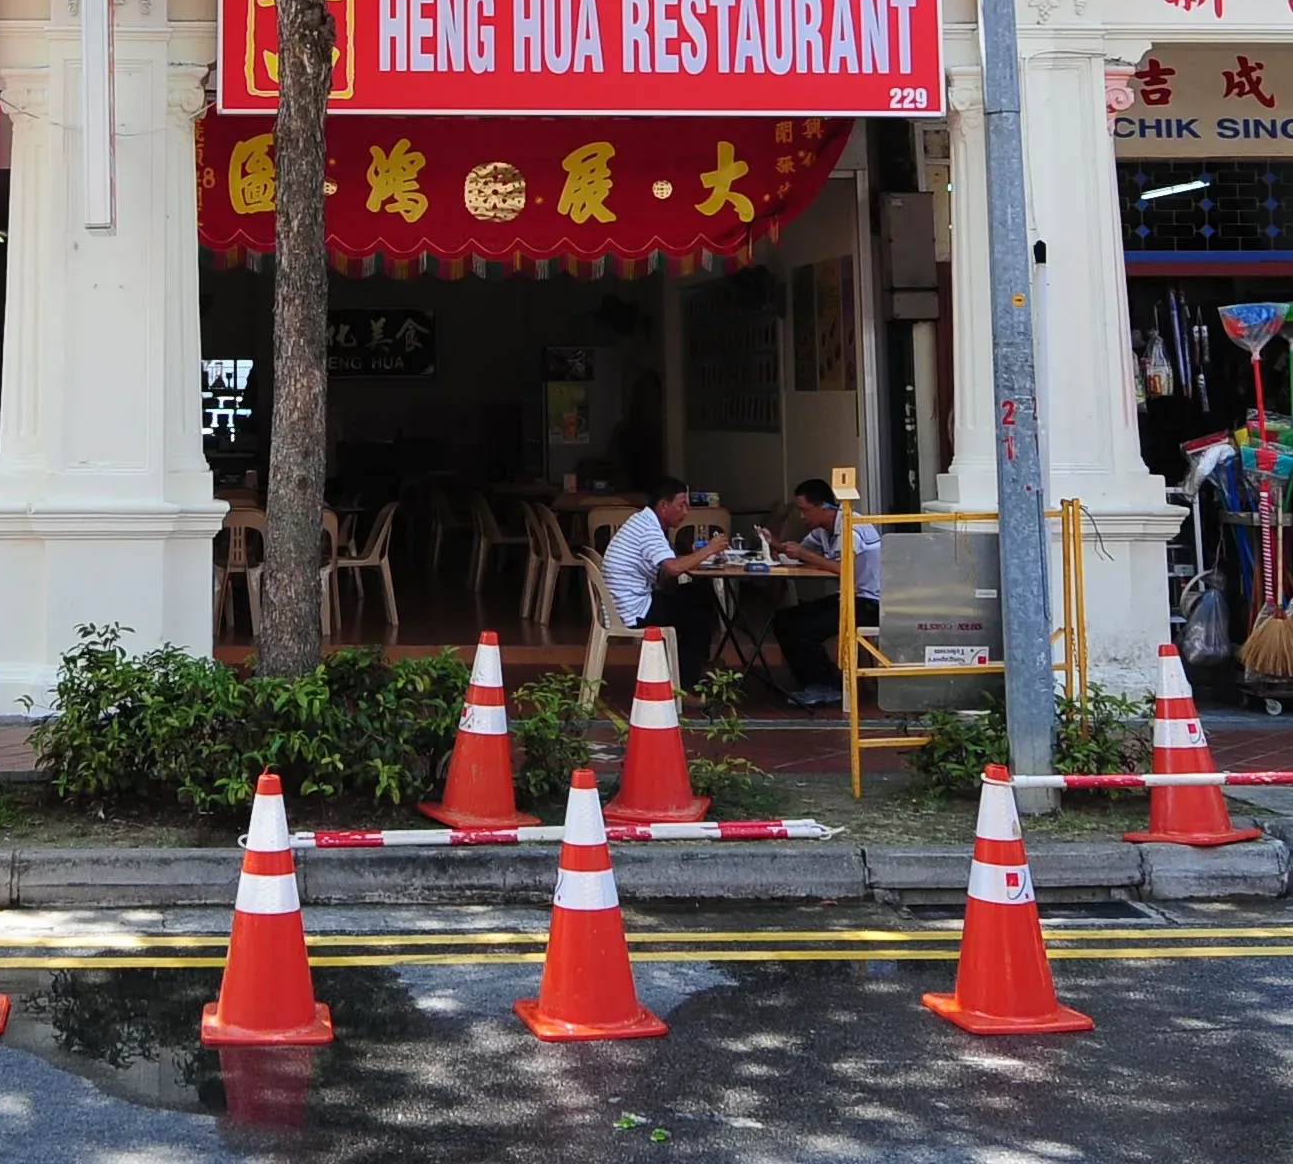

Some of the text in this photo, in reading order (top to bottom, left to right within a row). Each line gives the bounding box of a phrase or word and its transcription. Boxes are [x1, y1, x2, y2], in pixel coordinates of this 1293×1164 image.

[888, 88, 928, 110] 229
[1114, 117, 1202, 139] CHIK
[371, 356, 405, 369] HUA
